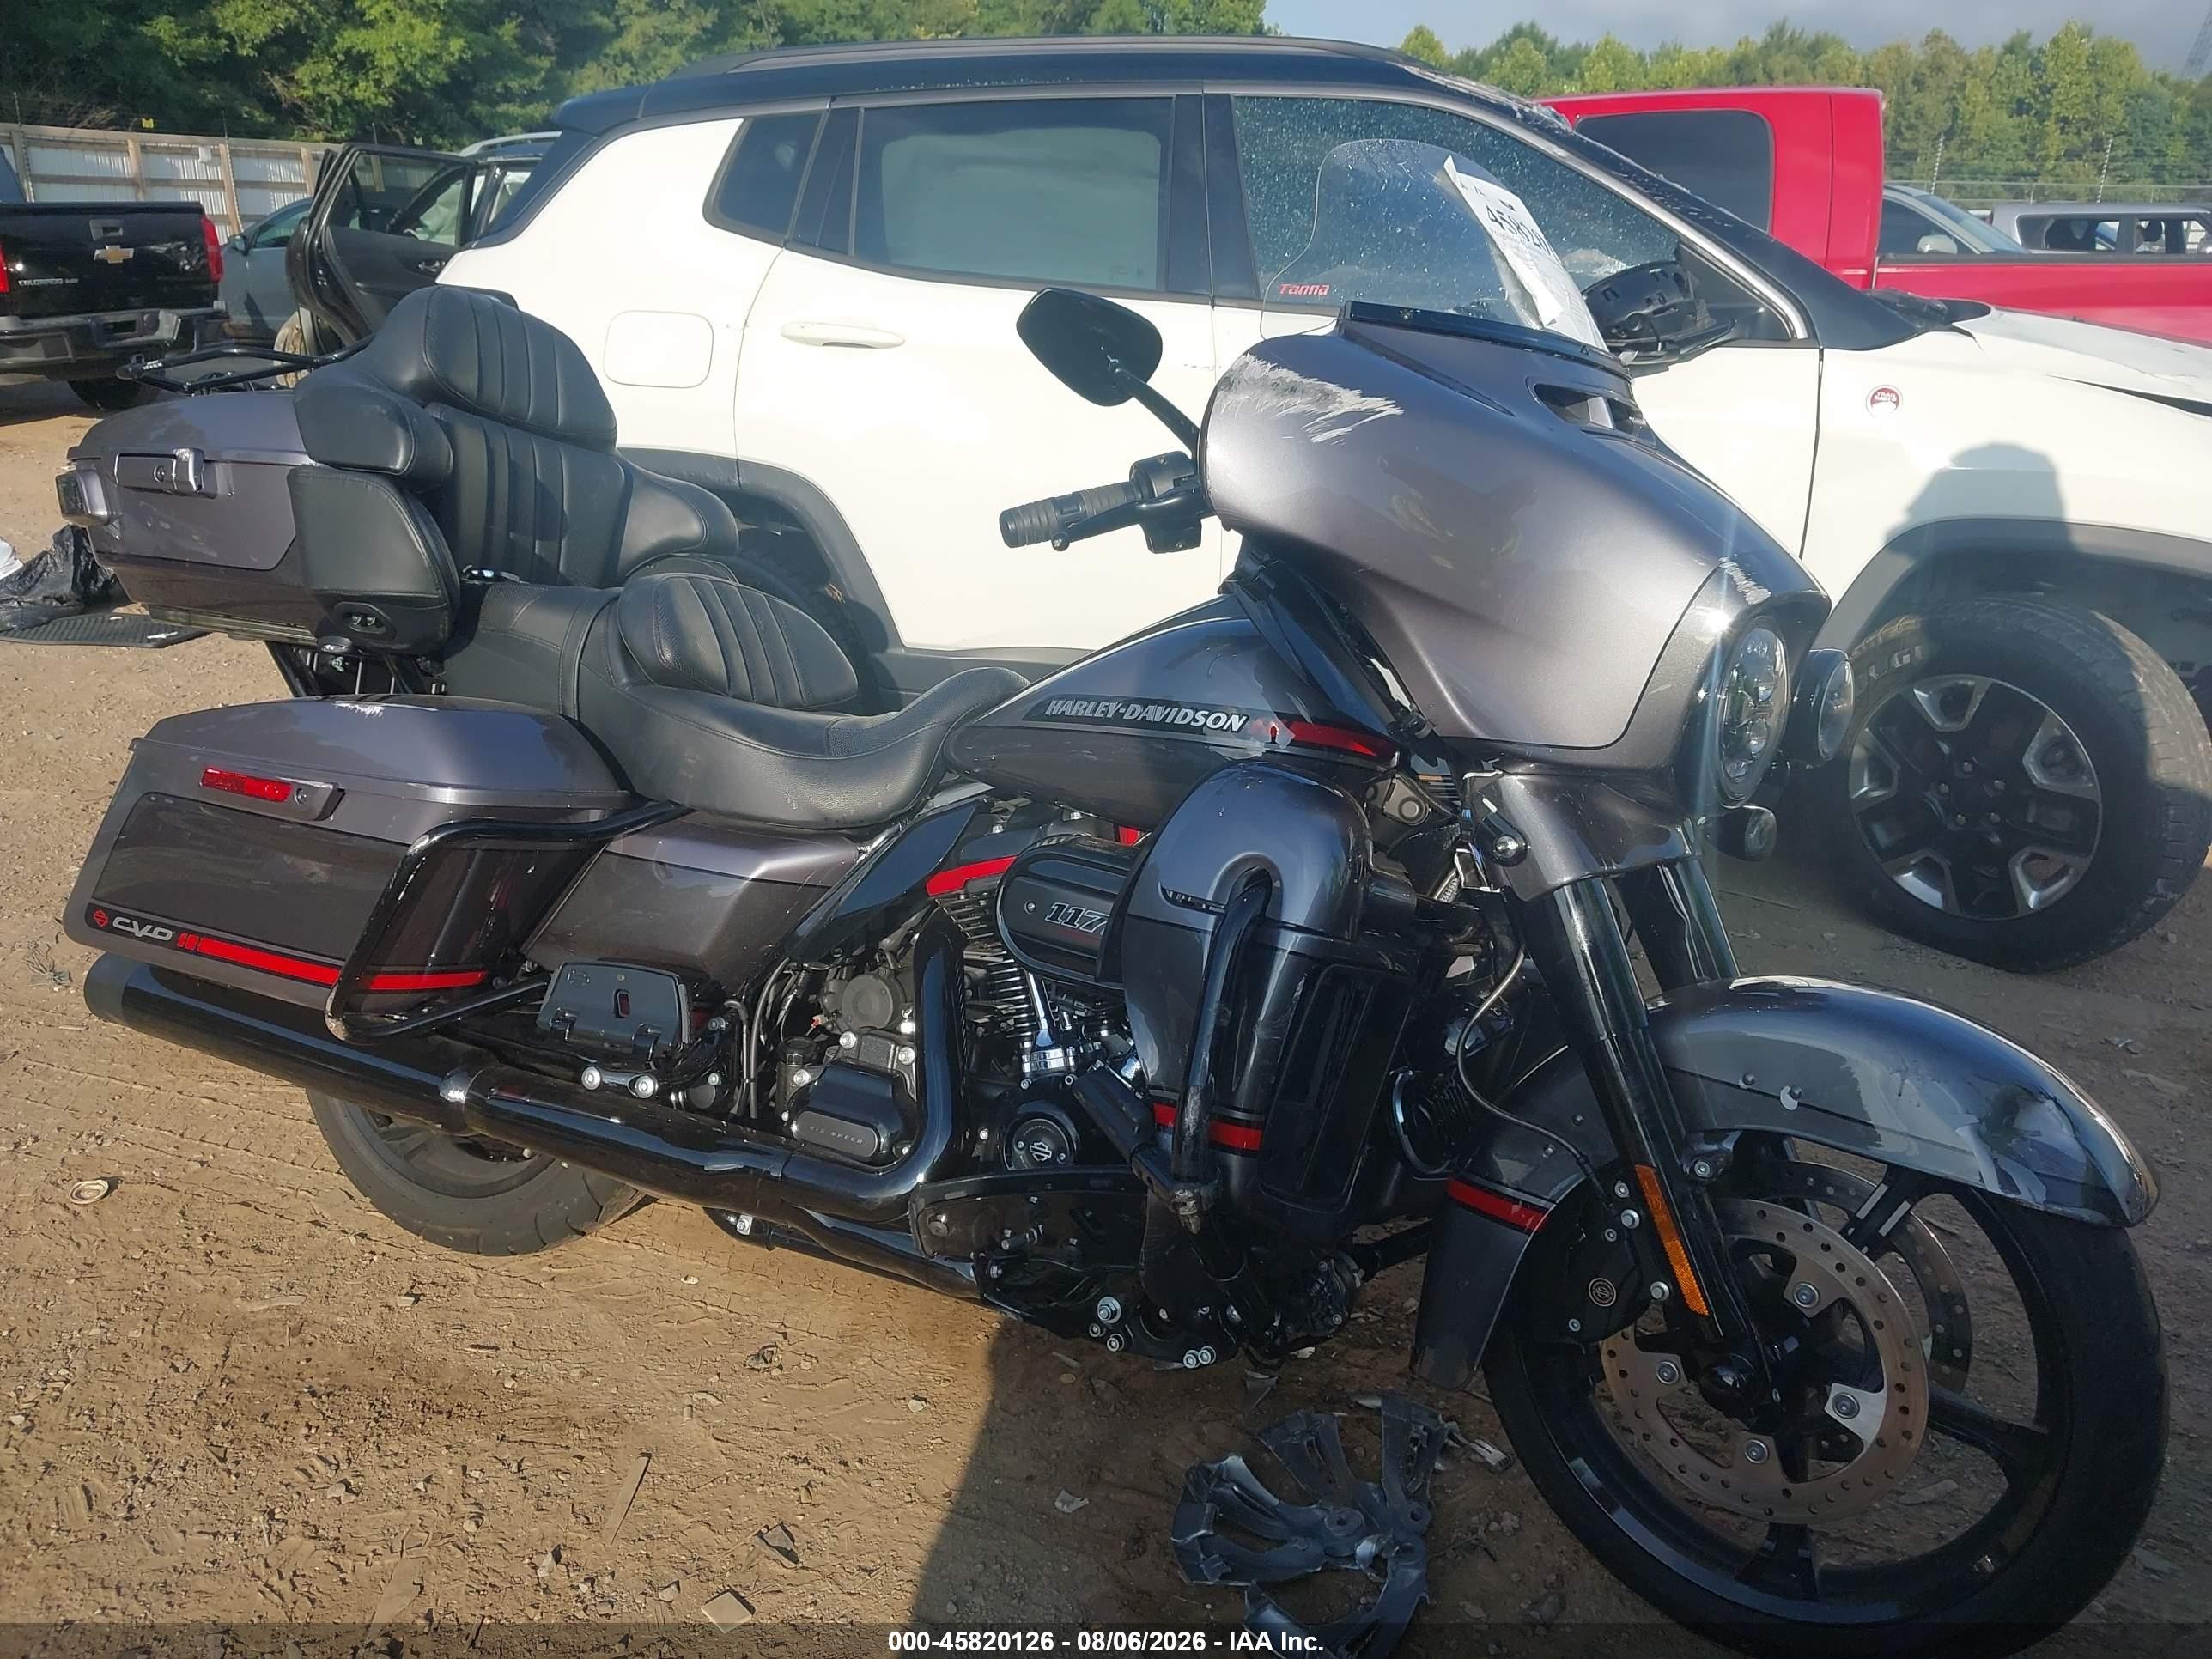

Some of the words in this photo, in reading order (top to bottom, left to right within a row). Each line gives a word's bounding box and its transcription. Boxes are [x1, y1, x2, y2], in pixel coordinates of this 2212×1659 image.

[1045, 699, 1248, 732] HARLEY-DAVIDSON
[112, 915, 173, 941] CVO
[1044, 902, 1110, 933] 117
